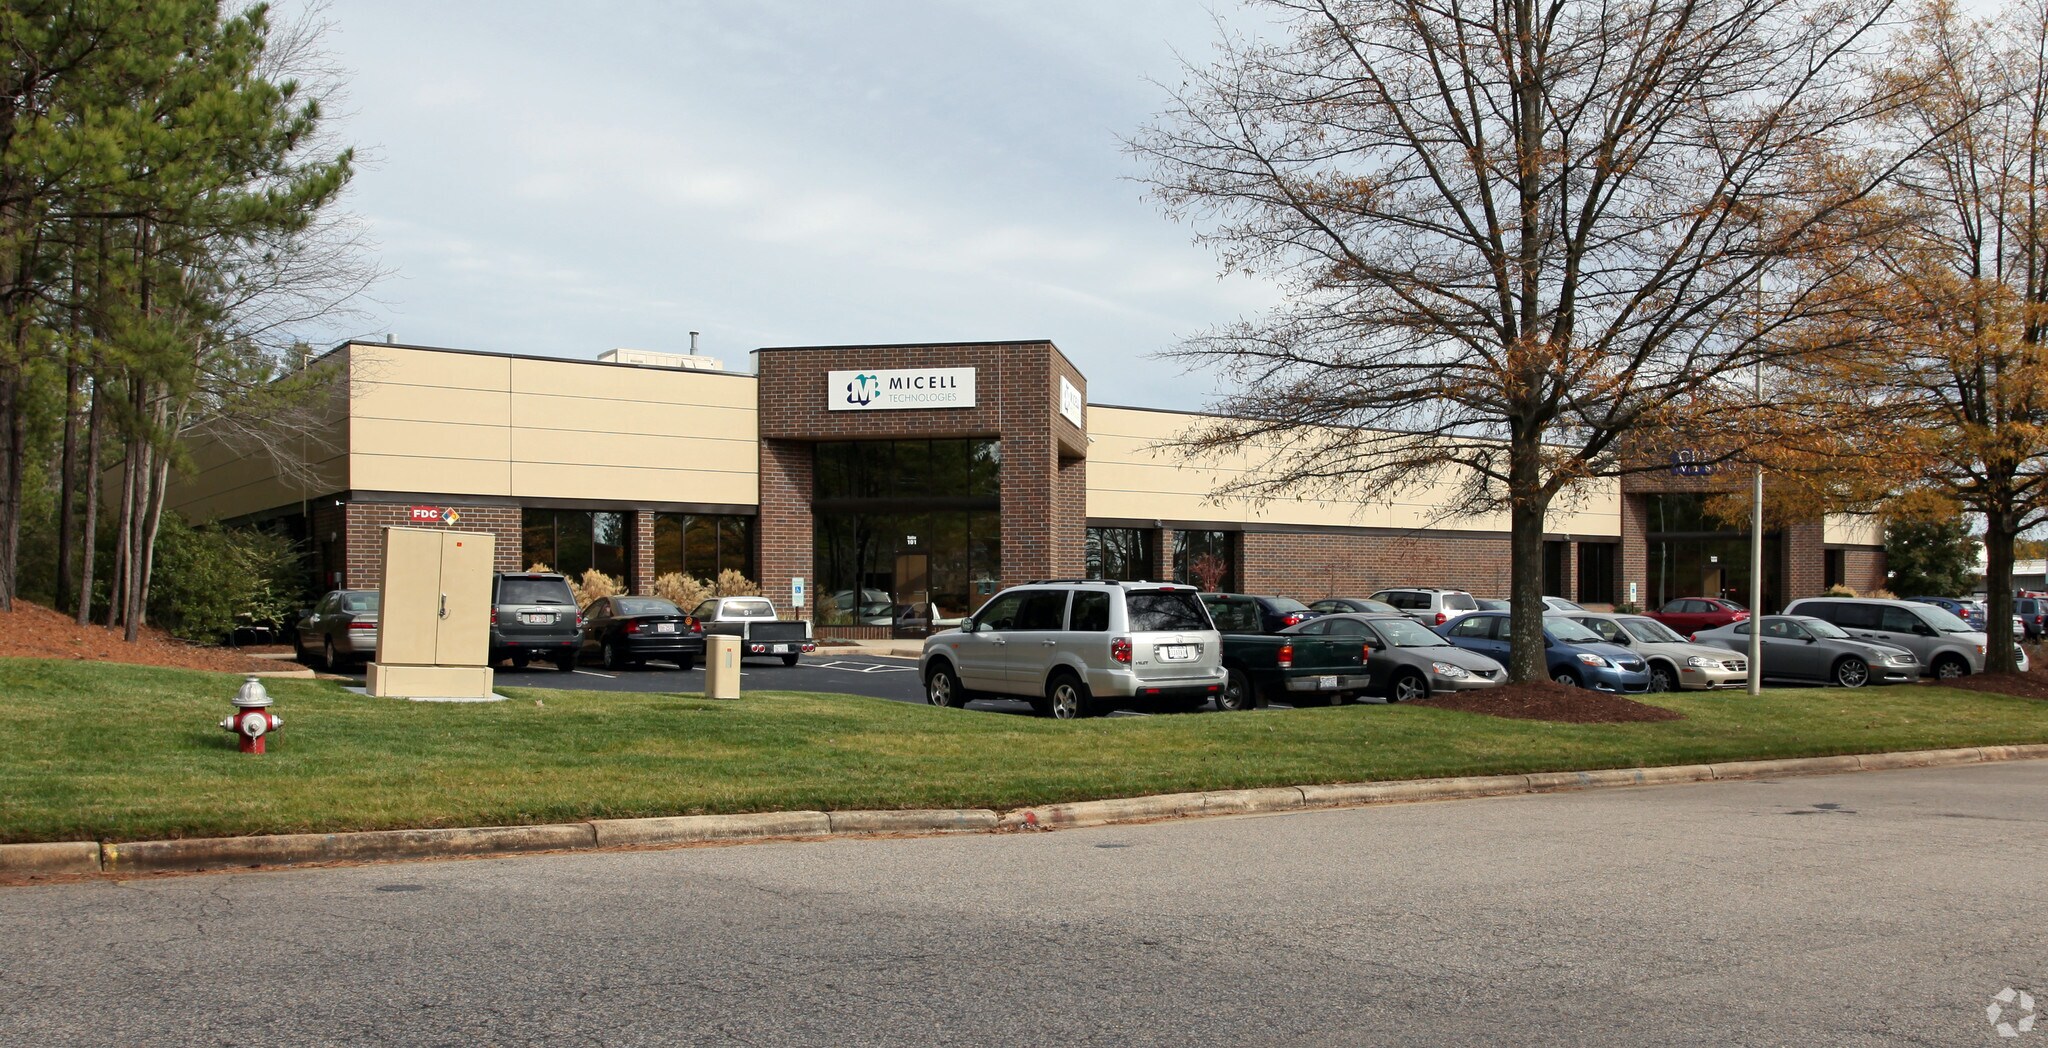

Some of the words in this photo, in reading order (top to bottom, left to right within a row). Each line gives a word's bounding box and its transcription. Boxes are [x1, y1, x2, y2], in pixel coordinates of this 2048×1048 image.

[889, 376, 957, 390] MICELL
[889, 392, 957, 403] TECHNOLOGIES
[413, 509, 438, 518] FDC
